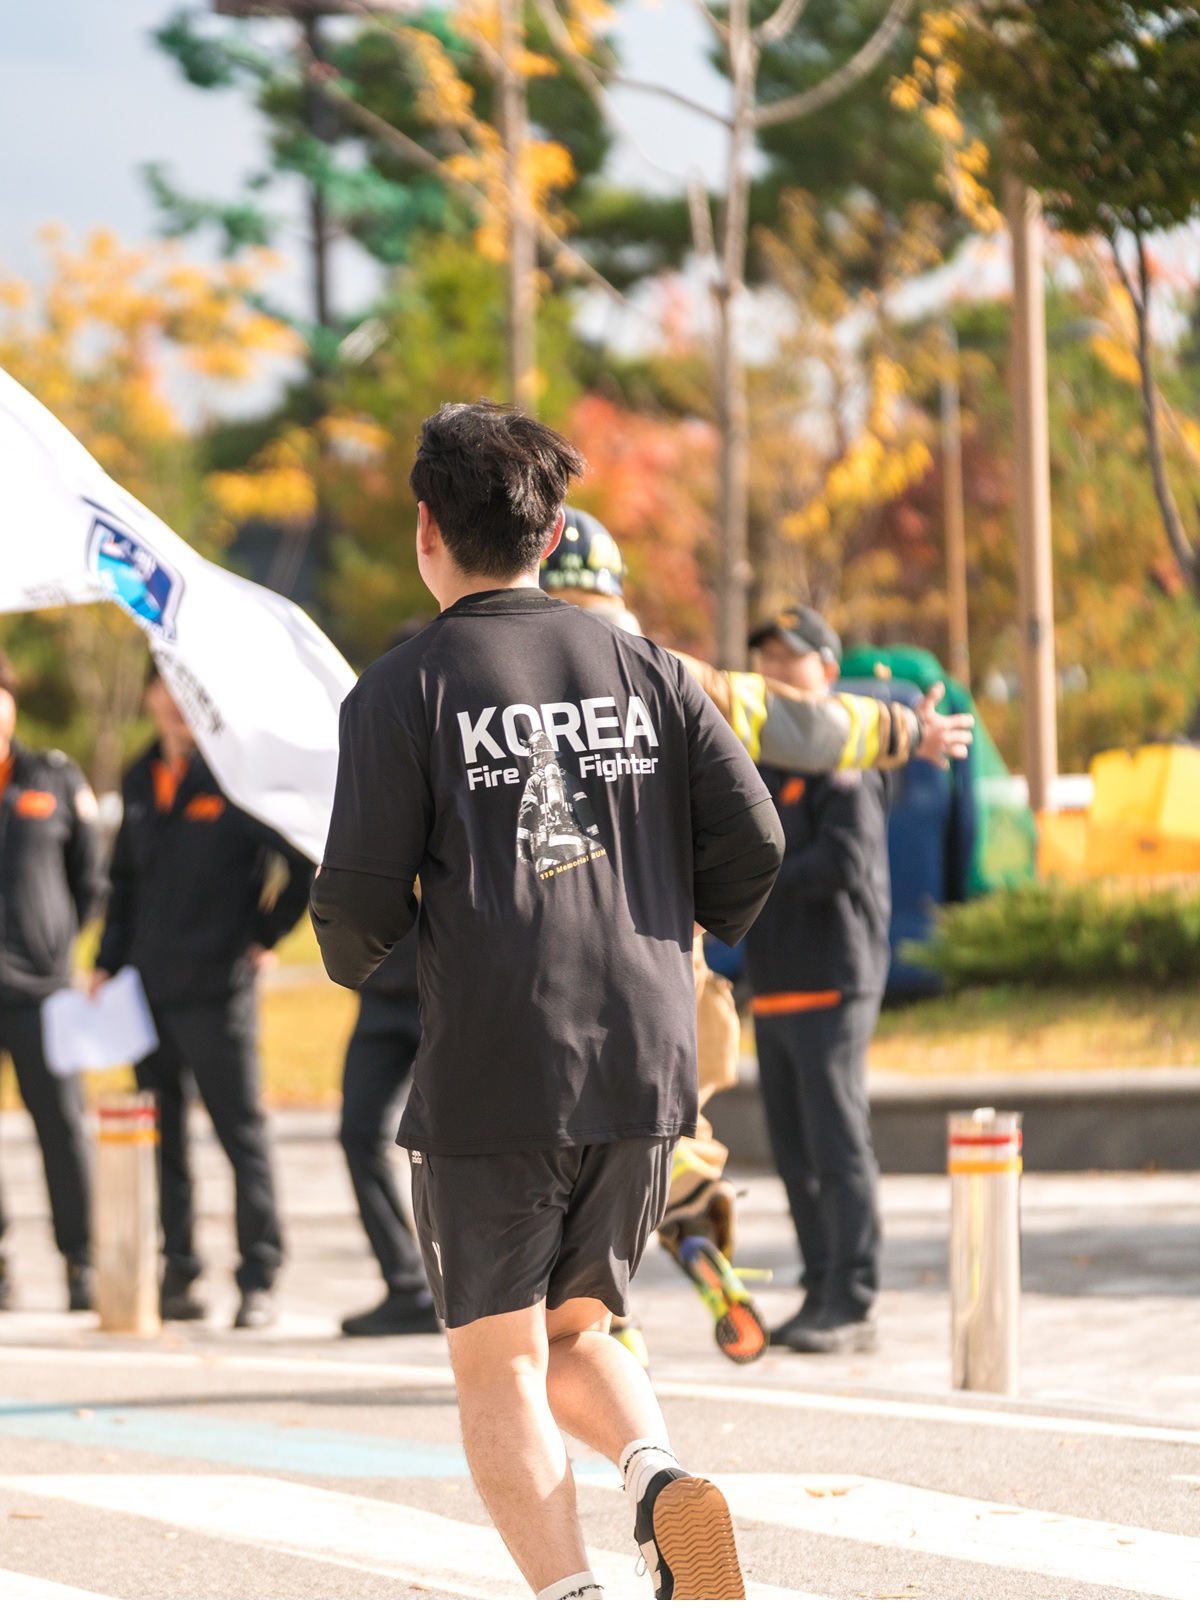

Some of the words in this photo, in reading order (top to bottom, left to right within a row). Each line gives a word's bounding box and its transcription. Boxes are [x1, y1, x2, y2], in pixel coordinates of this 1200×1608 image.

[457, 696, 659, 764] KOREA
[467, 765, 520, 791] Fire
[578, 753, 658, 782] Fighter
[556, 855, 589, 873] Memorial
[591, 848, 606, 859] RUN
